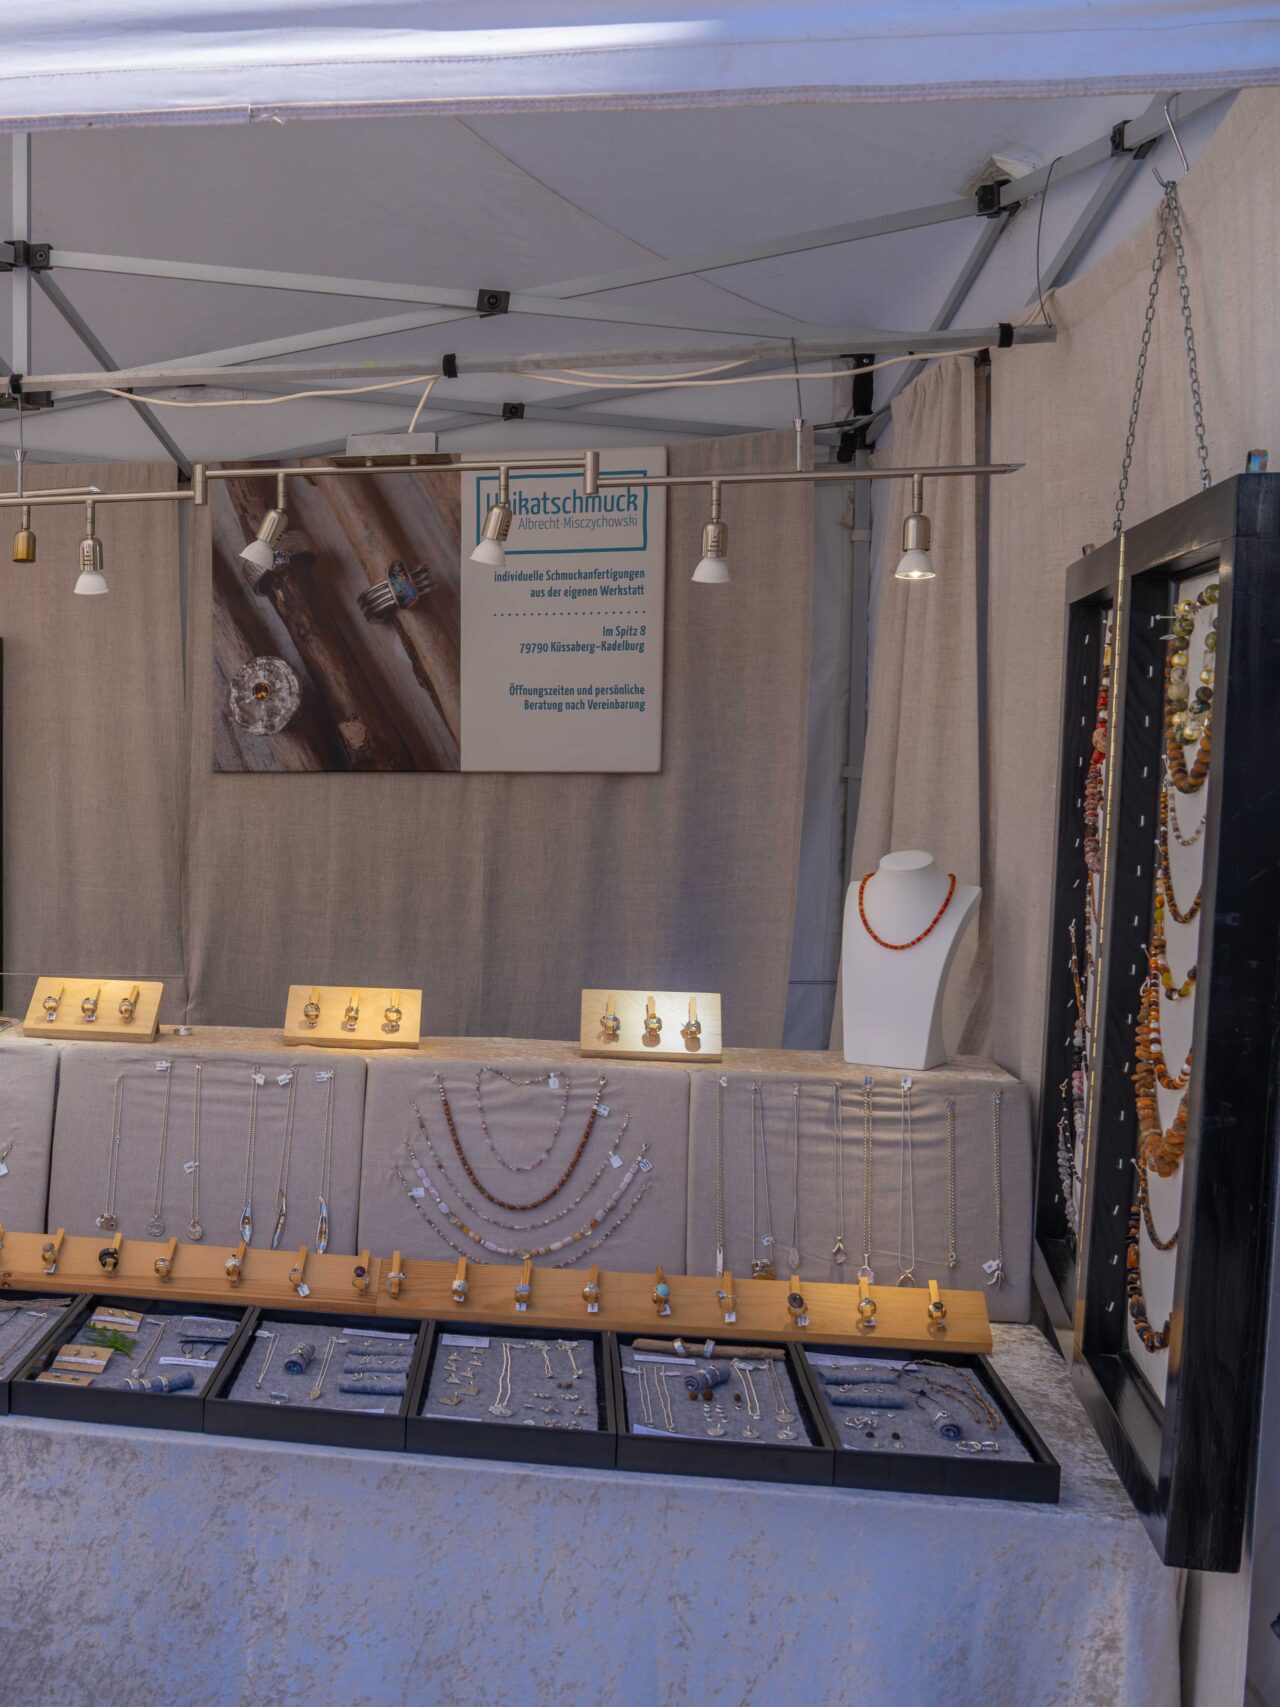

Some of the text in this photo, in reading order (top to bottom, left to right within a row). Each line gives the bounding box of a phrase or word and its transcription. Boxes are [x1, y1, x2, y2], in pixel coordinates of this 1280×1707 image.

[494, 568, 645, 582] individuelle Schmuckanfertigungen
[530, 585, 645, 599] aus der eigenen Werkstatt
[615, 625, 638, 639] Spitz
[640, 625, 646, 636] 8
[520, 643, 548, 654] 79790
[509, 682, 645, 698] Öffnungszeiten und persönliche
[524, 698, 646, 712] Beratung nach Vereinbarung
